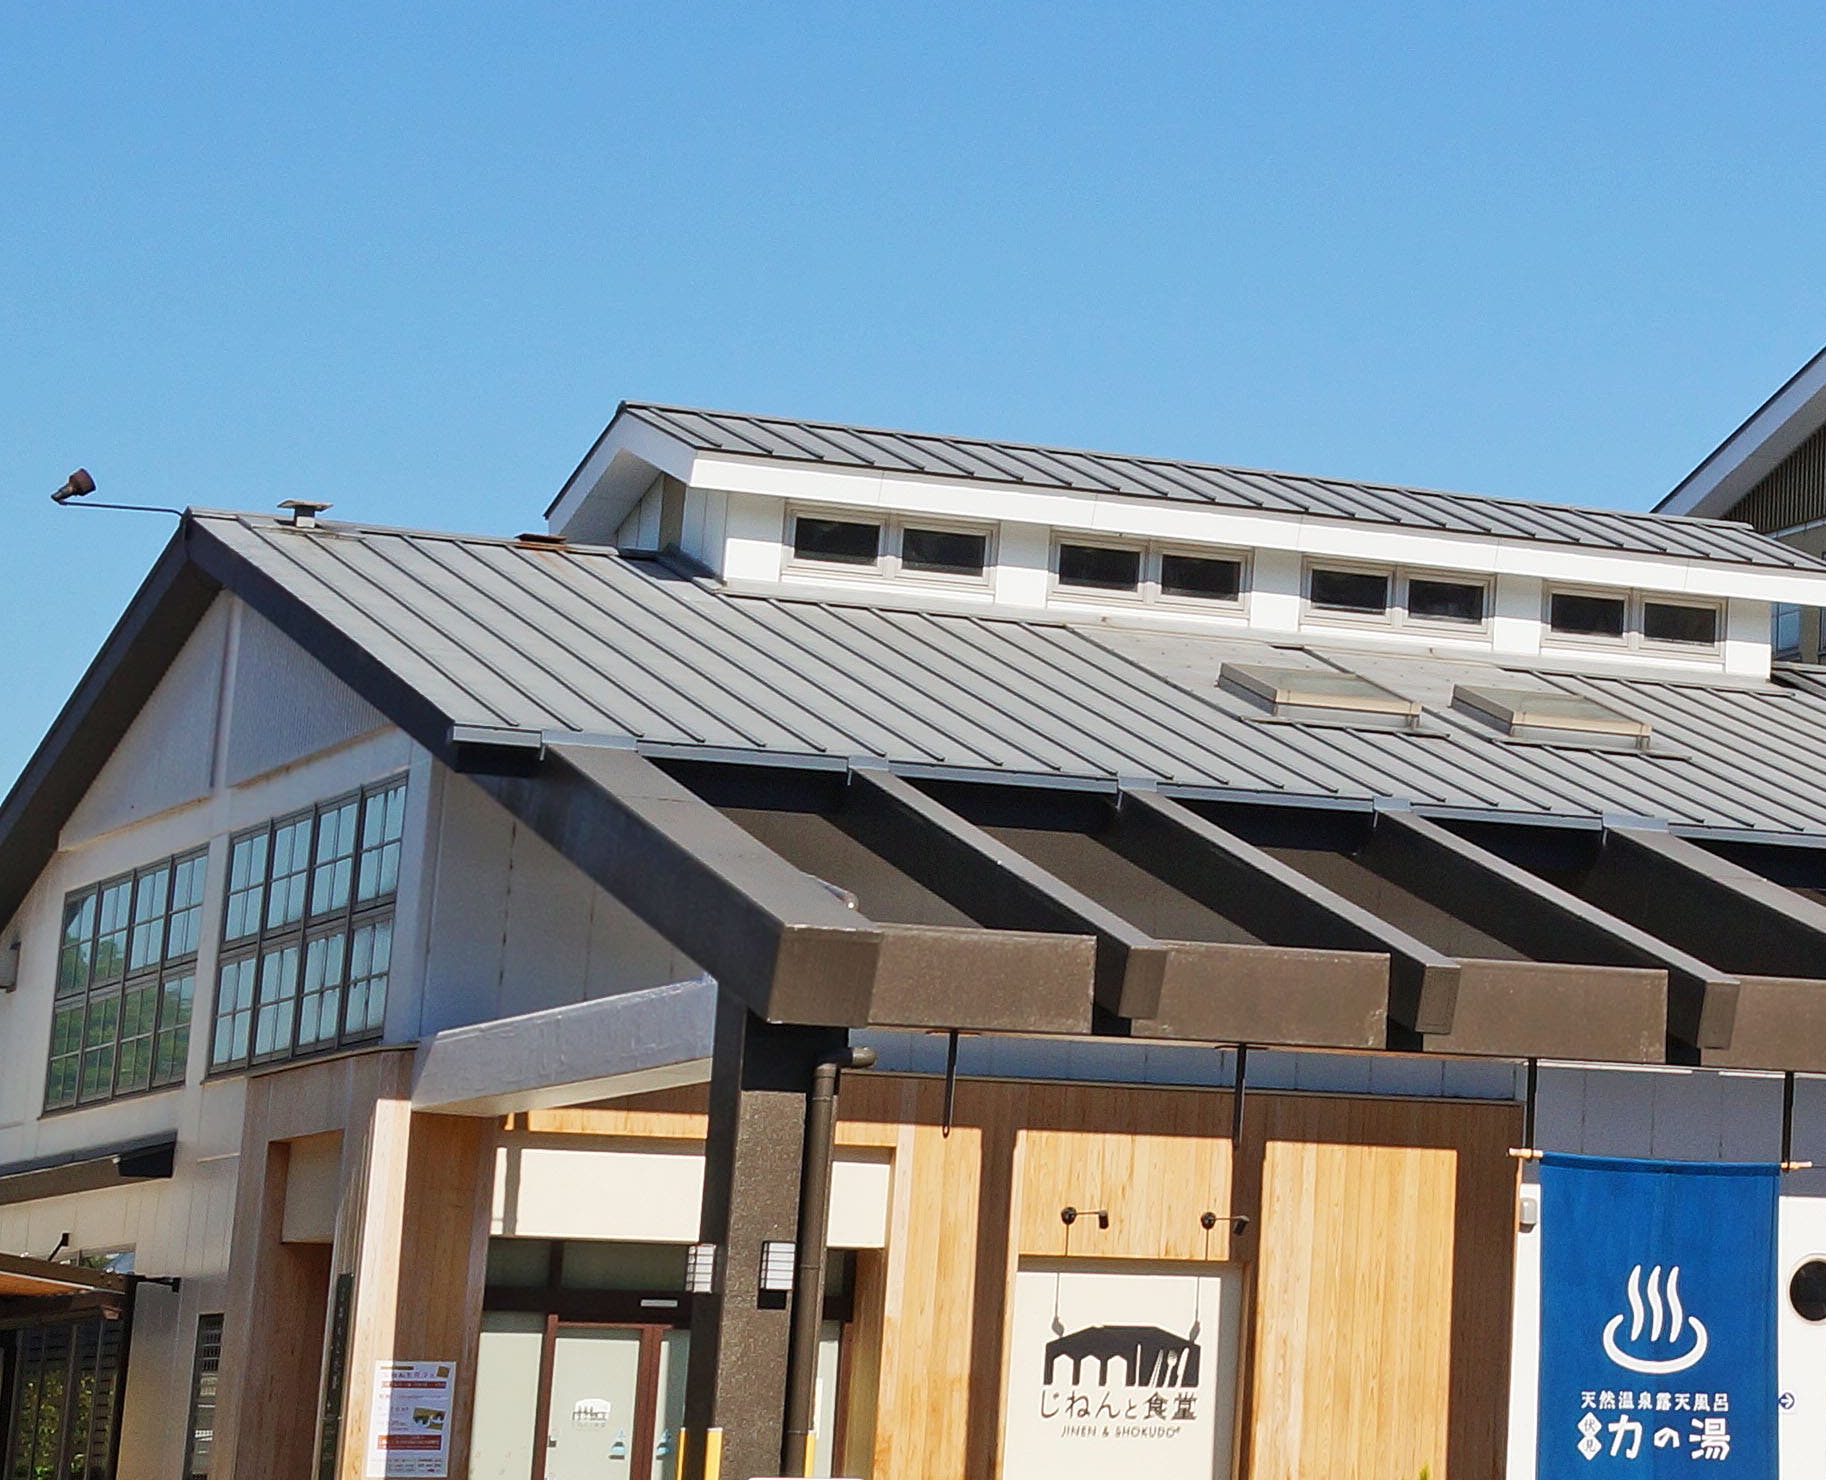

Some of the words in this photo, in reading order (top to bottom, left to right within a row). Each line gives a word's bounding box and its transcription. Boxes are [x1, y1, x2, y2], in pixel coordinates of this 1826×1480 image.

[1041, 1390, 1198, 1420] じねんと食堂
[1581, 1390, 1729, 1412] 天然温泉露天風呂
[1608, 1414, 1731, 1461] 力の湯
